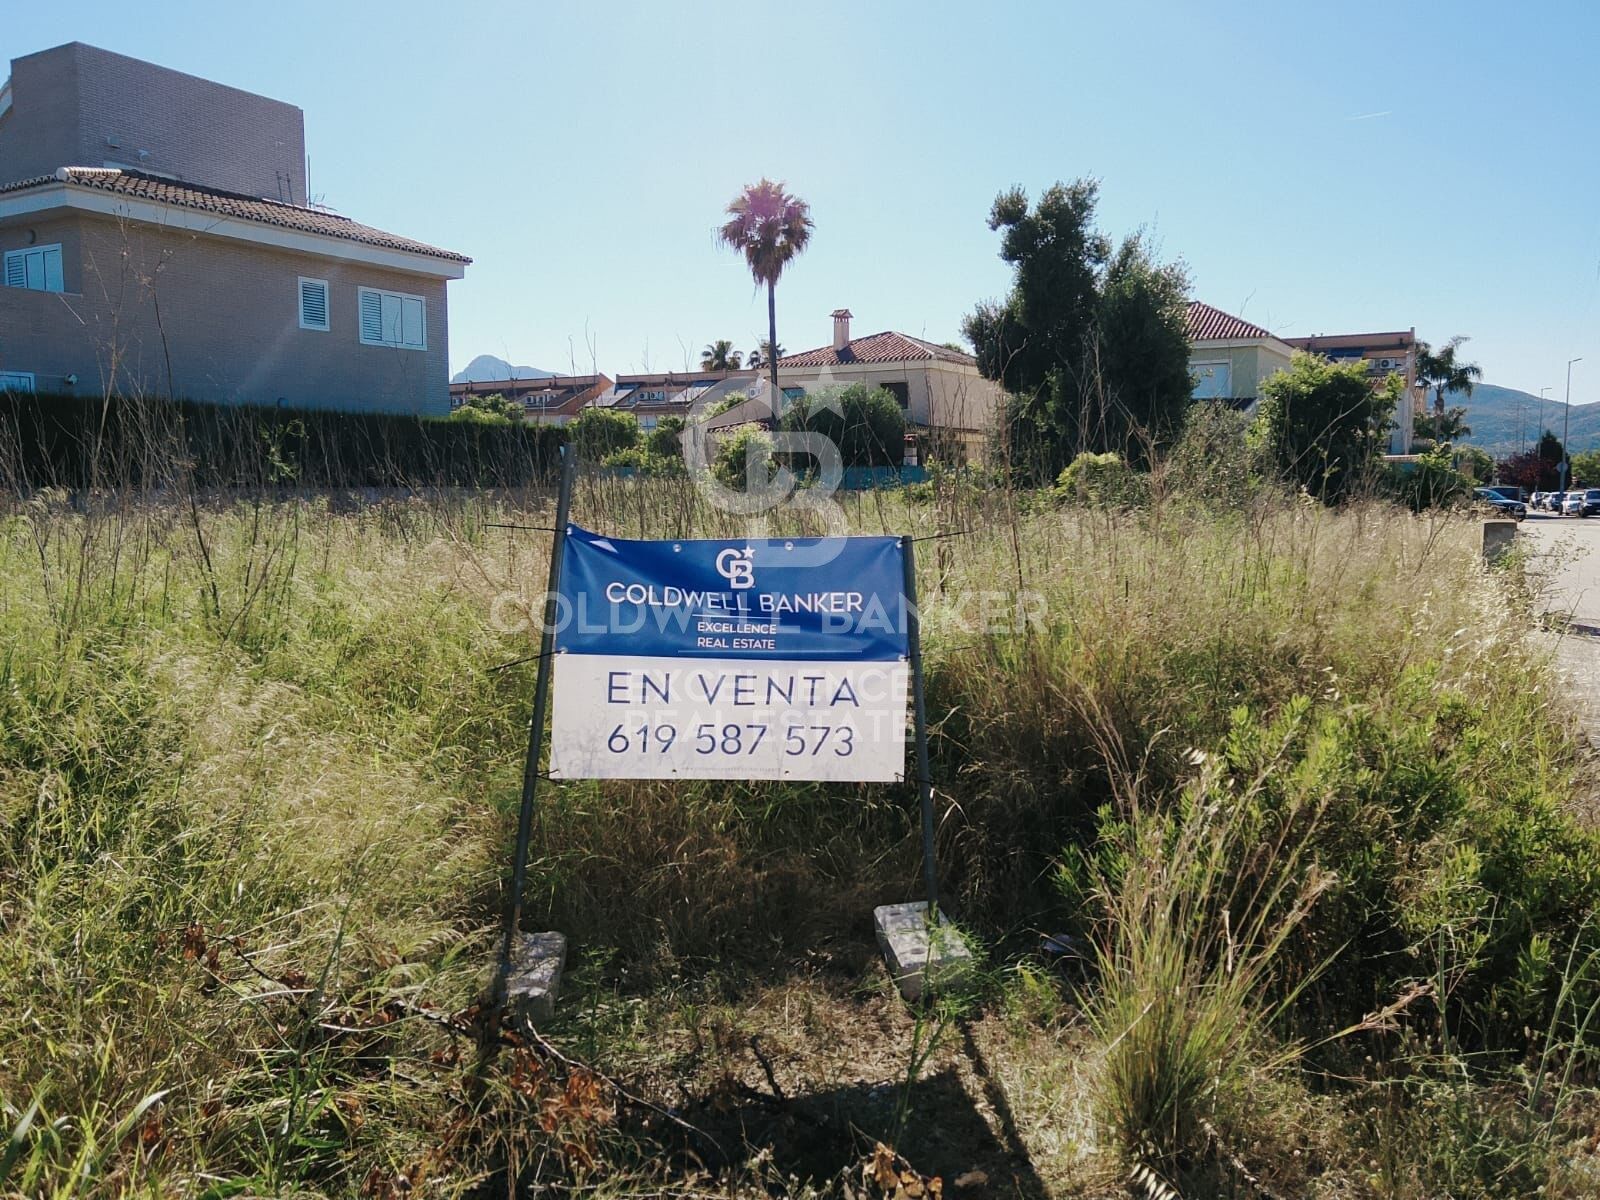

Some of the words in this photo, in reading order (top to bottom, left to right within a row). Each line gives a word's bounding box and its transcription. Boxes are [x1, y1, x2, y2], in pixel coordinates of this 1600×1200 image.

[606, 582, 752, 611] COLDWELL
[759, 592, 863, 613] BANKER
[697, 622, 777, 635] EXCELLENCE
[697, 638, 729, 649] REAL
[733, 639, 776, 650] ESTATE
[607, 671, 671, 704] EN
[698, 673, 860, 707] VENTA
[607, 724, 677, 754] 619
[695, 724, 768, 755] 587
[785, 725, 854, 757] 573
